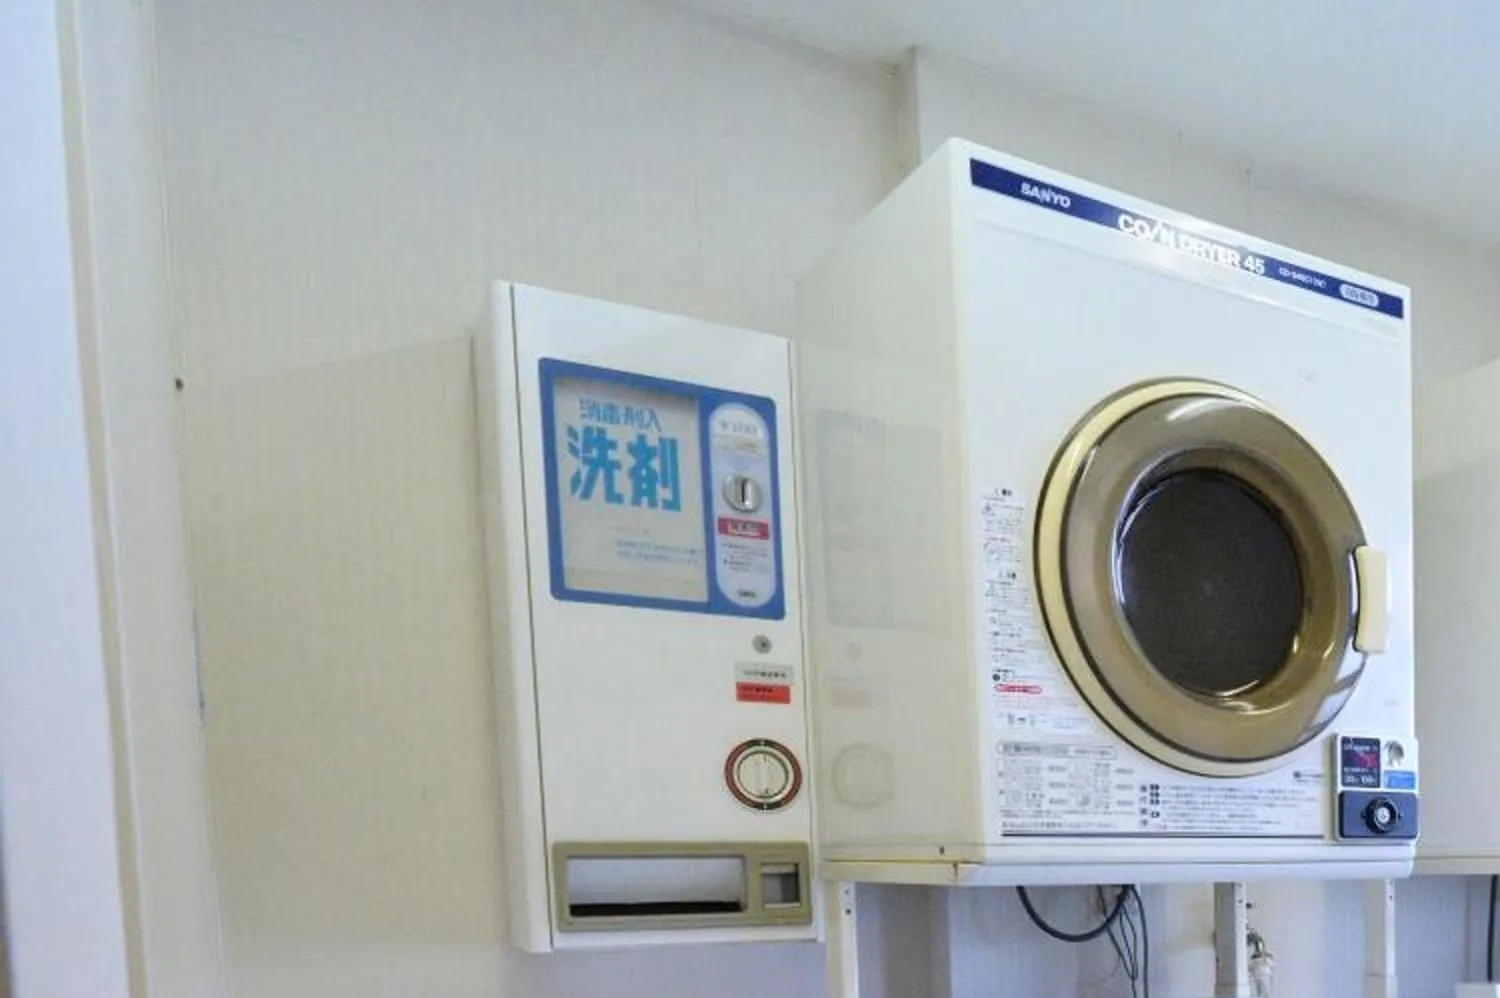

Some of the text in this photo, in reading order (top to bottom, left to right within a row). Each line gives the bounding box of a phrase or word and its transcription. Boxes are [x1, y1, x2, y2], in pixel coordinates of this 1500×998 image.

[1021, 182, 1071, 208] SANYO
[1243, 255, 1266, 276] 45
[566, 424, 682, 512] 洗剤
